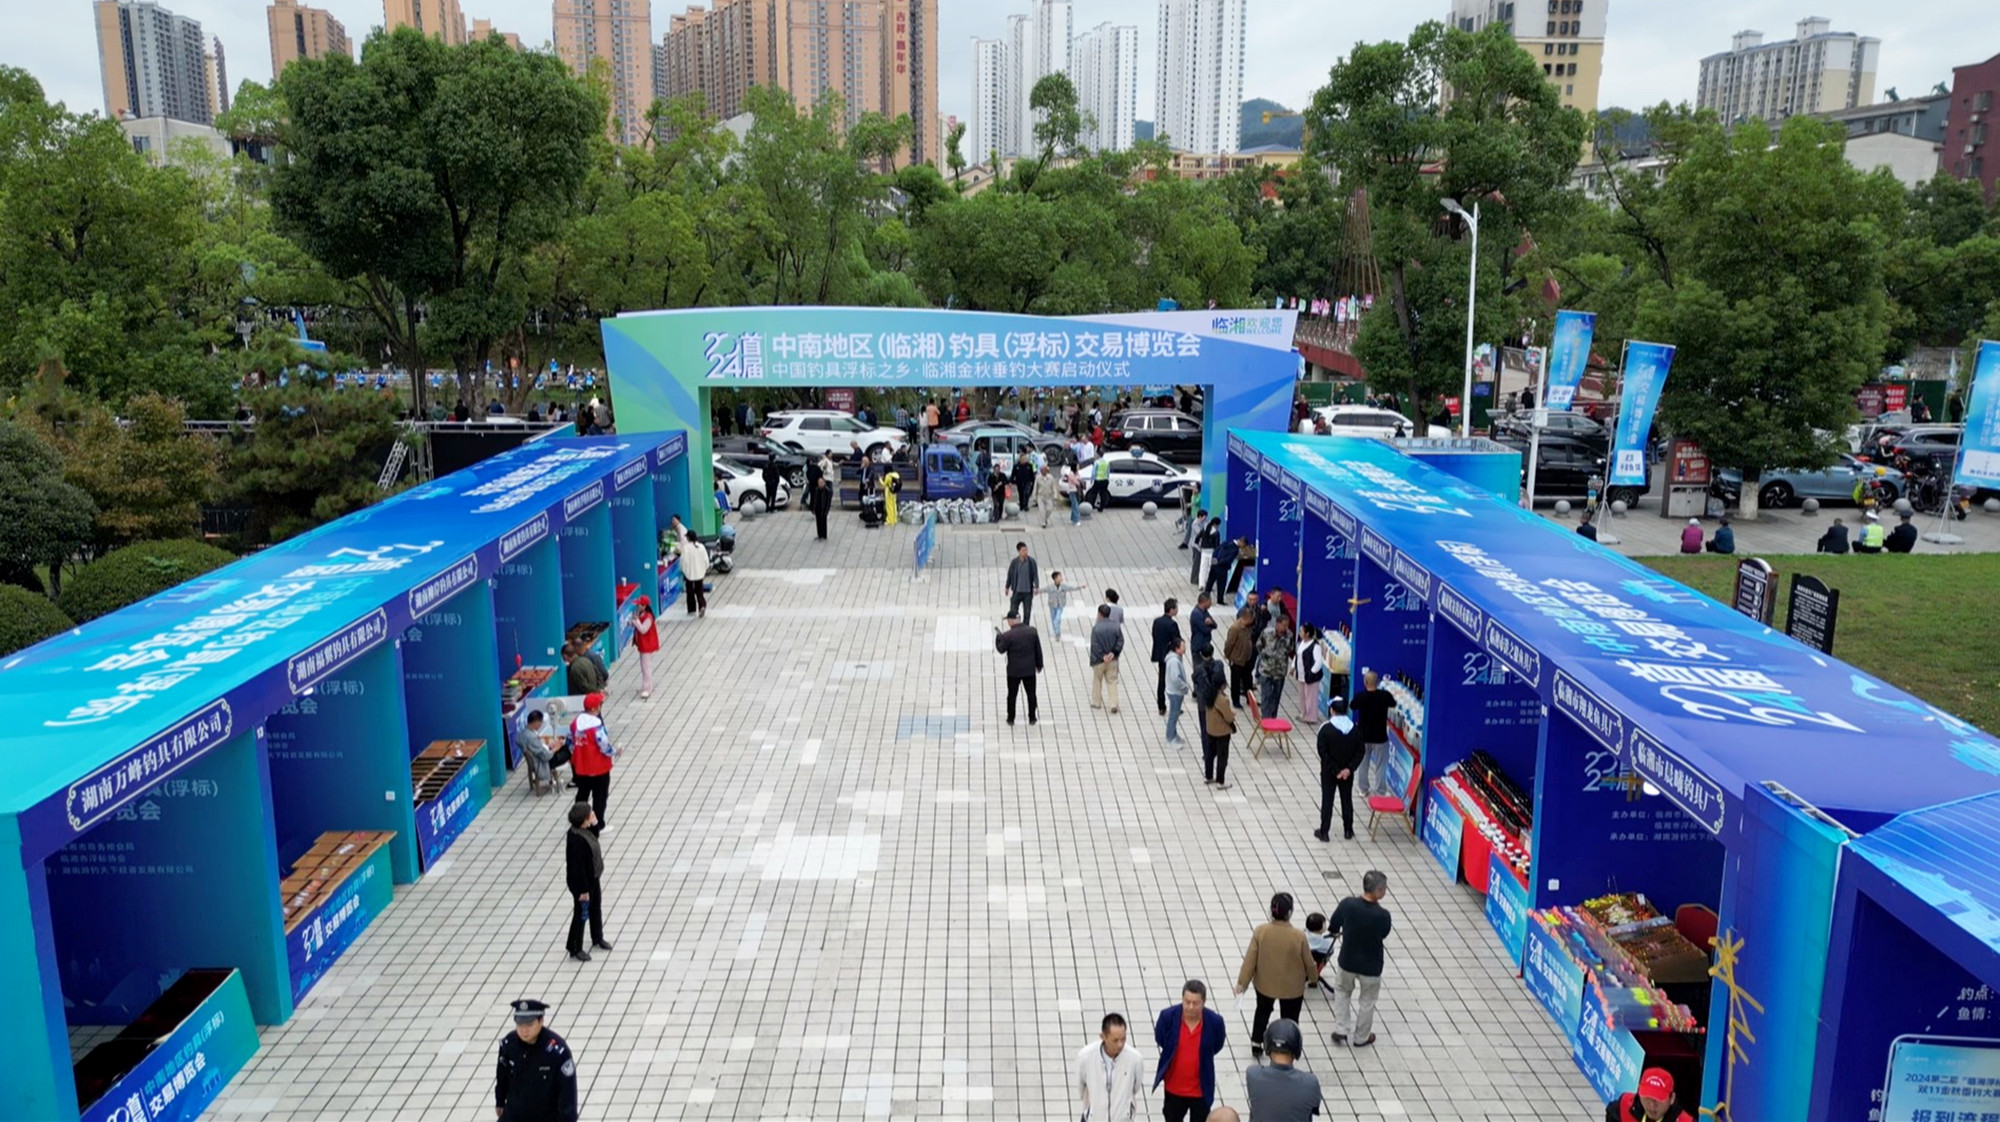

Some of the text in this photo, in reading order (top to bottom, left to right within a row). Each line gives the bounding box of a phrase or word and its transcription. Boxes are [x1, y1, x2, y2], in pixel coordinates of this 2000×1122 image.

[1212, 317, 1245, 334] 临湘
[1115, 478, 1135, 487] 公安
[80, 712, 222, 814] 湖南万峰钓具有限公司
[149, 1051, 206, 1119] 交易博览会
